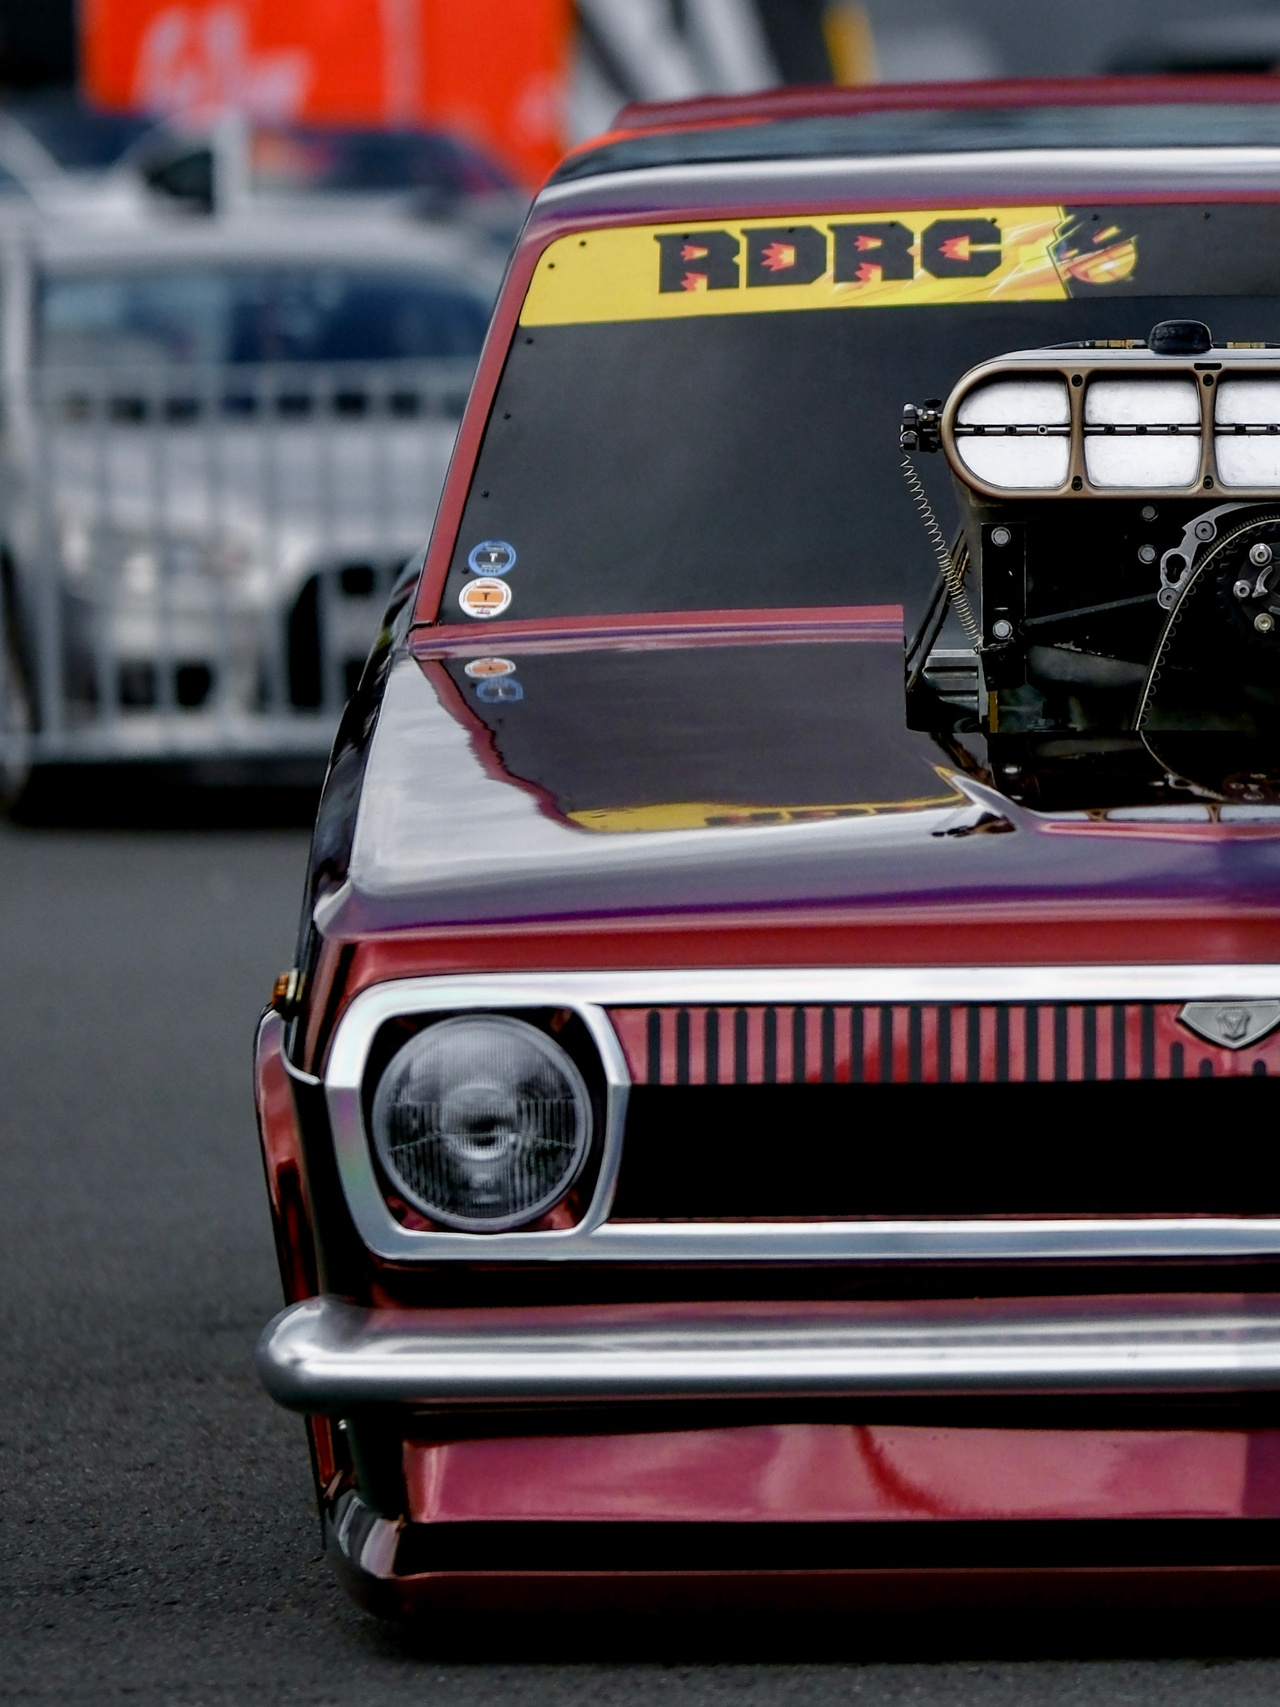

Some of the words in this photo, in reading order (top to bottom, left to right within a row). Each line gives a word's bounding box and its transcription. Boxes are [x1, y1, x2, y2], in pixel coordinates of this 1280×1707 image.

[653, 217, 1003, 294] RDRC
[490, 553, 498, 562] T
[482, 592, 491, 601] T
